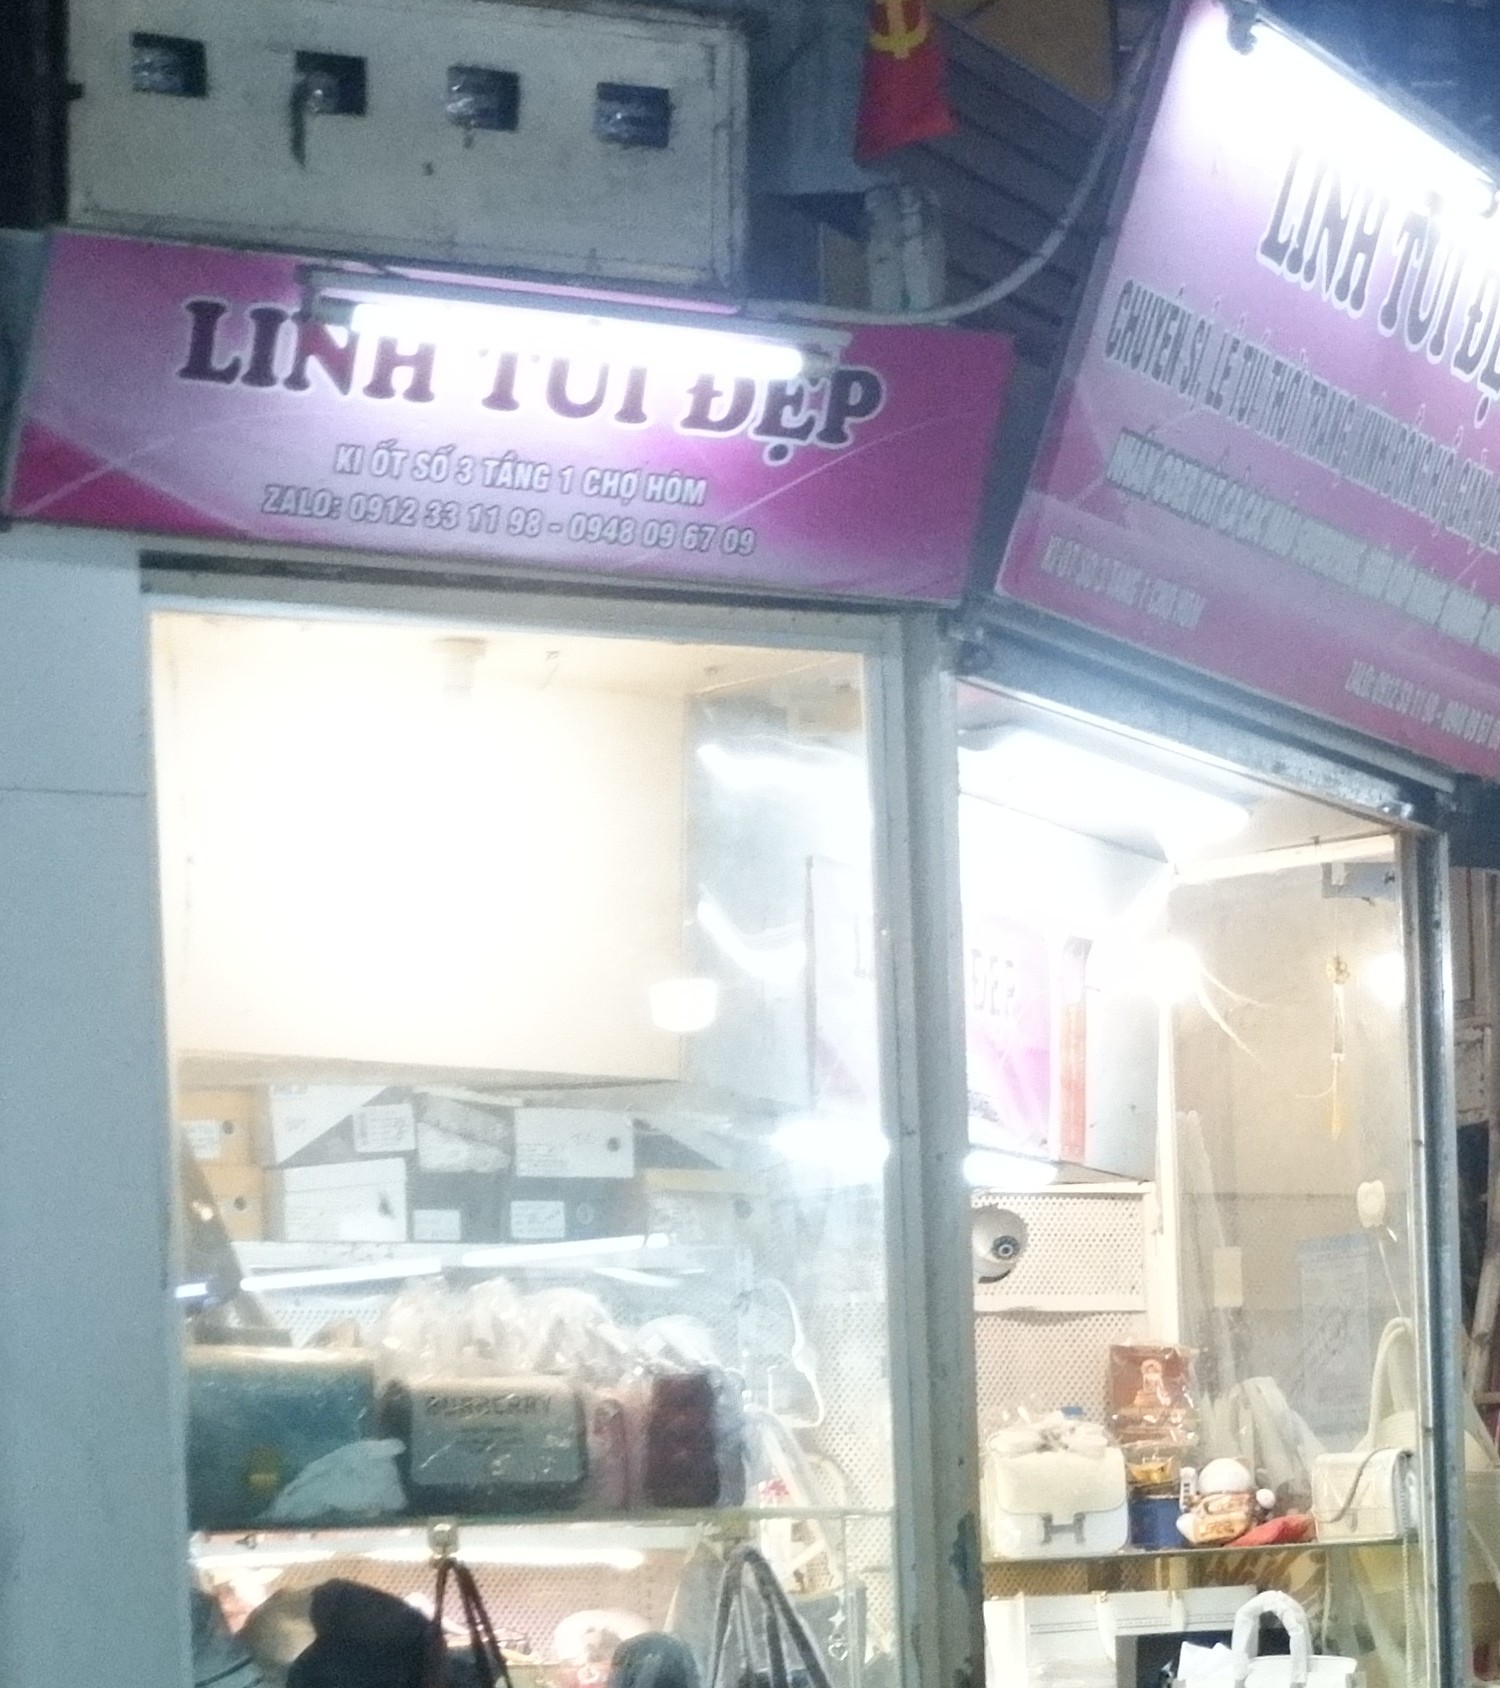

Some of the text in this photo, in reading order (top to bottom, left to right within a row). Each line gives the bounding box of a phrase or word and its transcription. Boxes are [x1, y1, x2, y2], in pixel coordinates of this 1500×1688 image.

[177, 297, 438, 405] LINH
[680, 366, 884, 464] ĐẸP
[334, 442, 364, 475] KI
[411, 443, 456, 483] SỐ
[455, 455, 475, 486] 3
[559, 465, 575, 495] 1
[583, 466, 642, 507] CHỢ
[645, 468, 709, 506] HÔM
[262, 483, 340, 520] ZALO:
[350, 492, 419, 527] 0912
[424, 499, 460, 530] 33
[468, 502, 500, 534] 11
[506, 507, 545, 538] 98
[568, 511, 637, 546] 0948
[641, 518, 678, 549] 09
[682, 522, 718, 553] 67
[721, 526, 758, 556] 09
